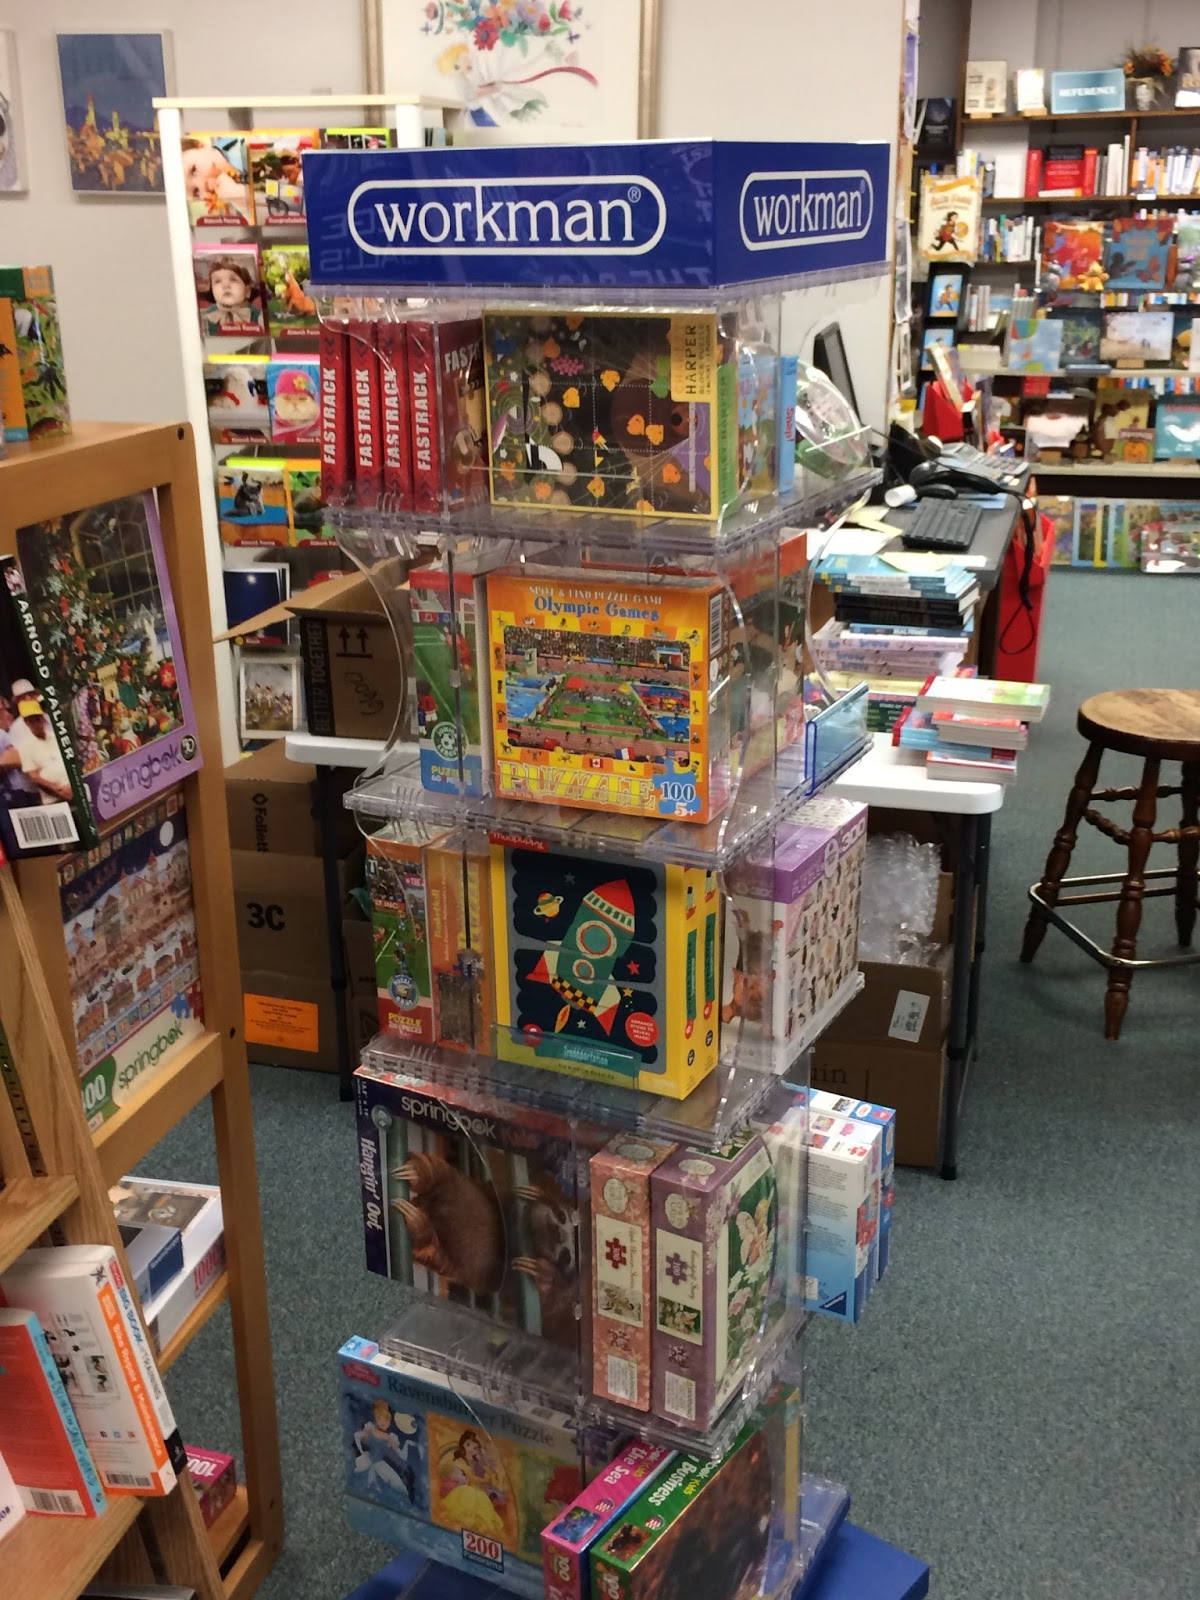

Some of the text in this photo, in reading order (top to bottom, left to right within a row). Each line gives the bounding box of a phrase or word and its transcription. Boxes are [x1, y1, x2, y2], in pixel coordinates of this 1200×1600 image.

[1059, 85, 1118, 97] REFERENCE
[374, 184, 635, 243] workman
[753, 178, 862, 237] workman
[685, 324, 697, 395] HARPER
[323, 367, 336, 465] FASTRACK
[355, 368, 373, 468] FASTRACK
[383, 367, 400, 468] FASTRACK
[412, 370, 432, 471] FASTRACK
[533, 595, 659, 622] Olympic Games
[17, 598, 74, 761] ARNOLD PALMER
[101, 744, 182, 808] springbok
[431, 765, 472, 779] PUZZE
[497, 760, 655, 811] PUZZLE
[660, 781, 696, 802] 100
[254, 804, 269, 853] Follett
[674, 802, 697, 817] 5+
[246, 901, 286, 932] 3C
[118, 1019, 184, 1090] springbok
[401, 1095, 497, 1140] springbok
[360, 1137, 383, 1232] Hangin' Out
[126, 1309, 143, 1343] BOOK
[501, 1413, 554, 1446] Puzzle
[603, 1446, 648, 1486] the Sea
[648, 1460, 699, 1507] Business
[683, 1477, 701, 1496] Kids
[464, 1532, 500, 1559] 200
[556, 1556, 571, 1582] 100
